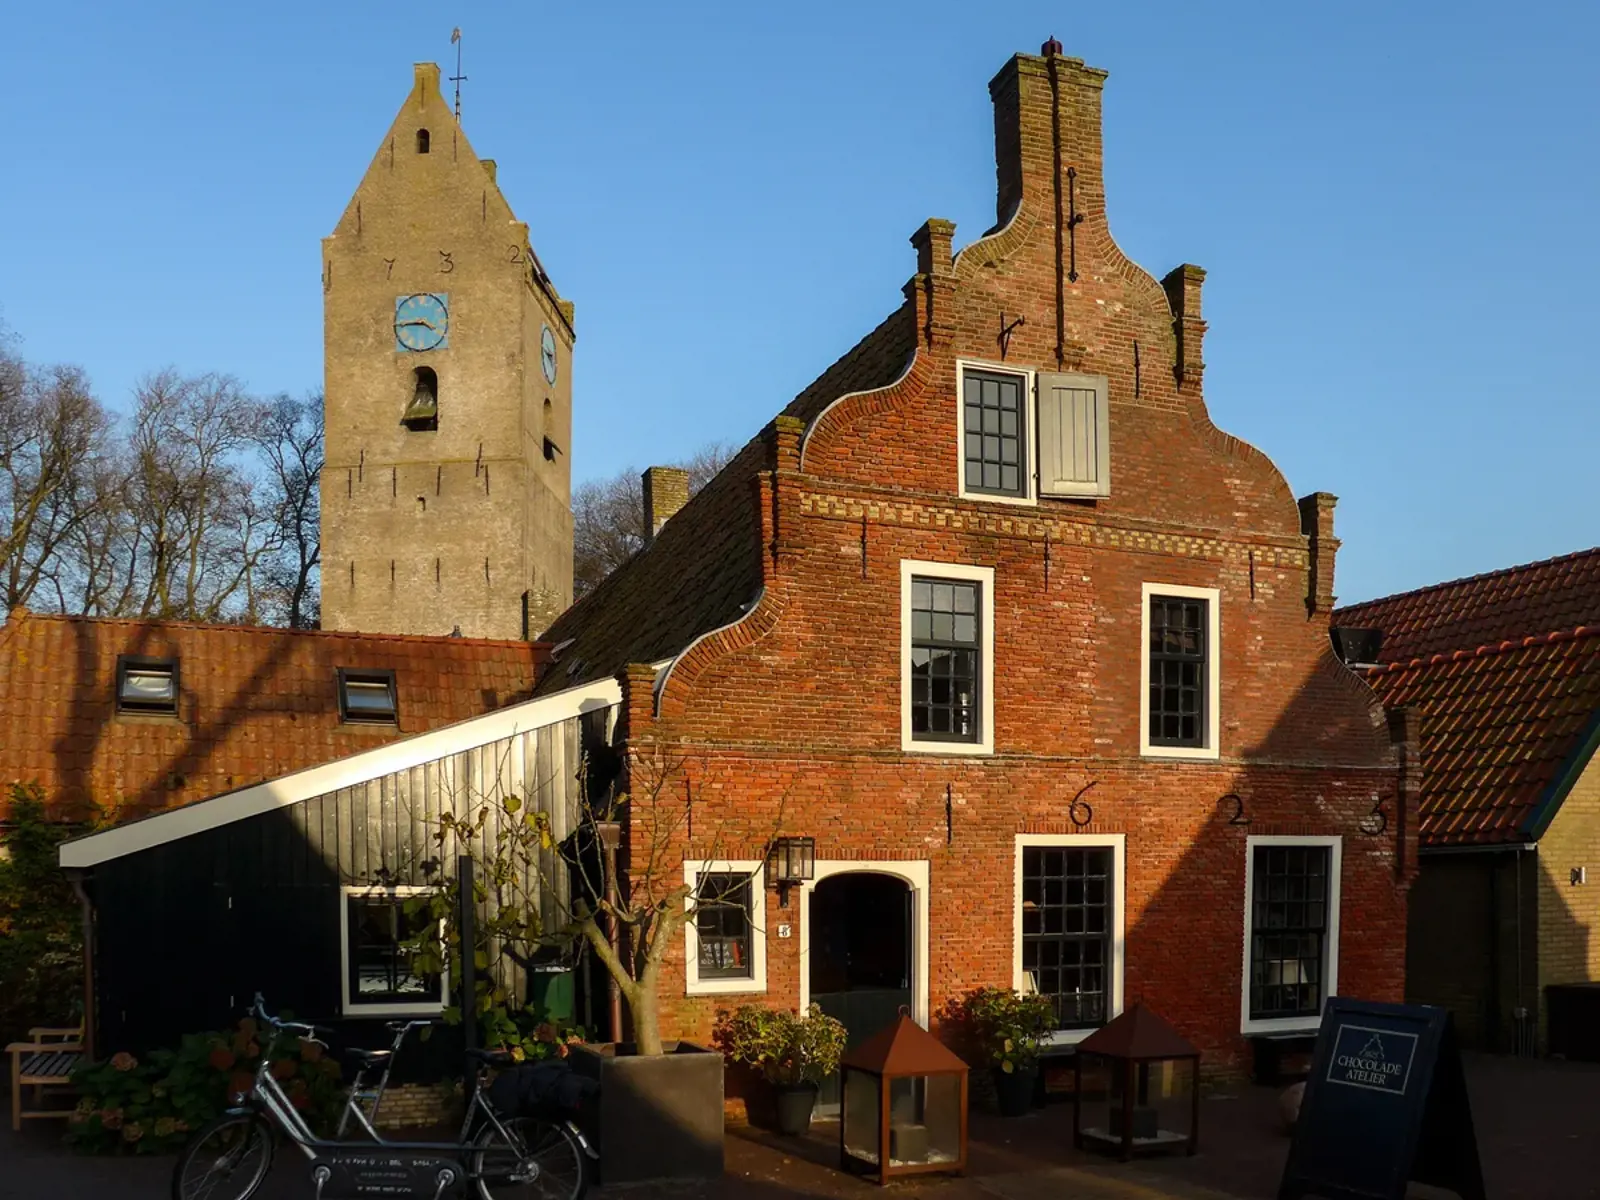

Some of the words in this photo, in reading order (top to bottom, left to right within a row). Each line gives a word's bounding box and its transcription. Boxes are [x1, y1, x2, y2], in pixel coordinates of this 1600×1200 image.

[439, 250, 455, 274] 3
[508, 245, 524, 264] 2
[1068, 781, 1098, 826] 6
[1217, 794, 1252, 826] 2
[1338, 1055, 1402, 1075] CHOCOLADE
[1346, 1069, 1386, 1085] ATELIER
